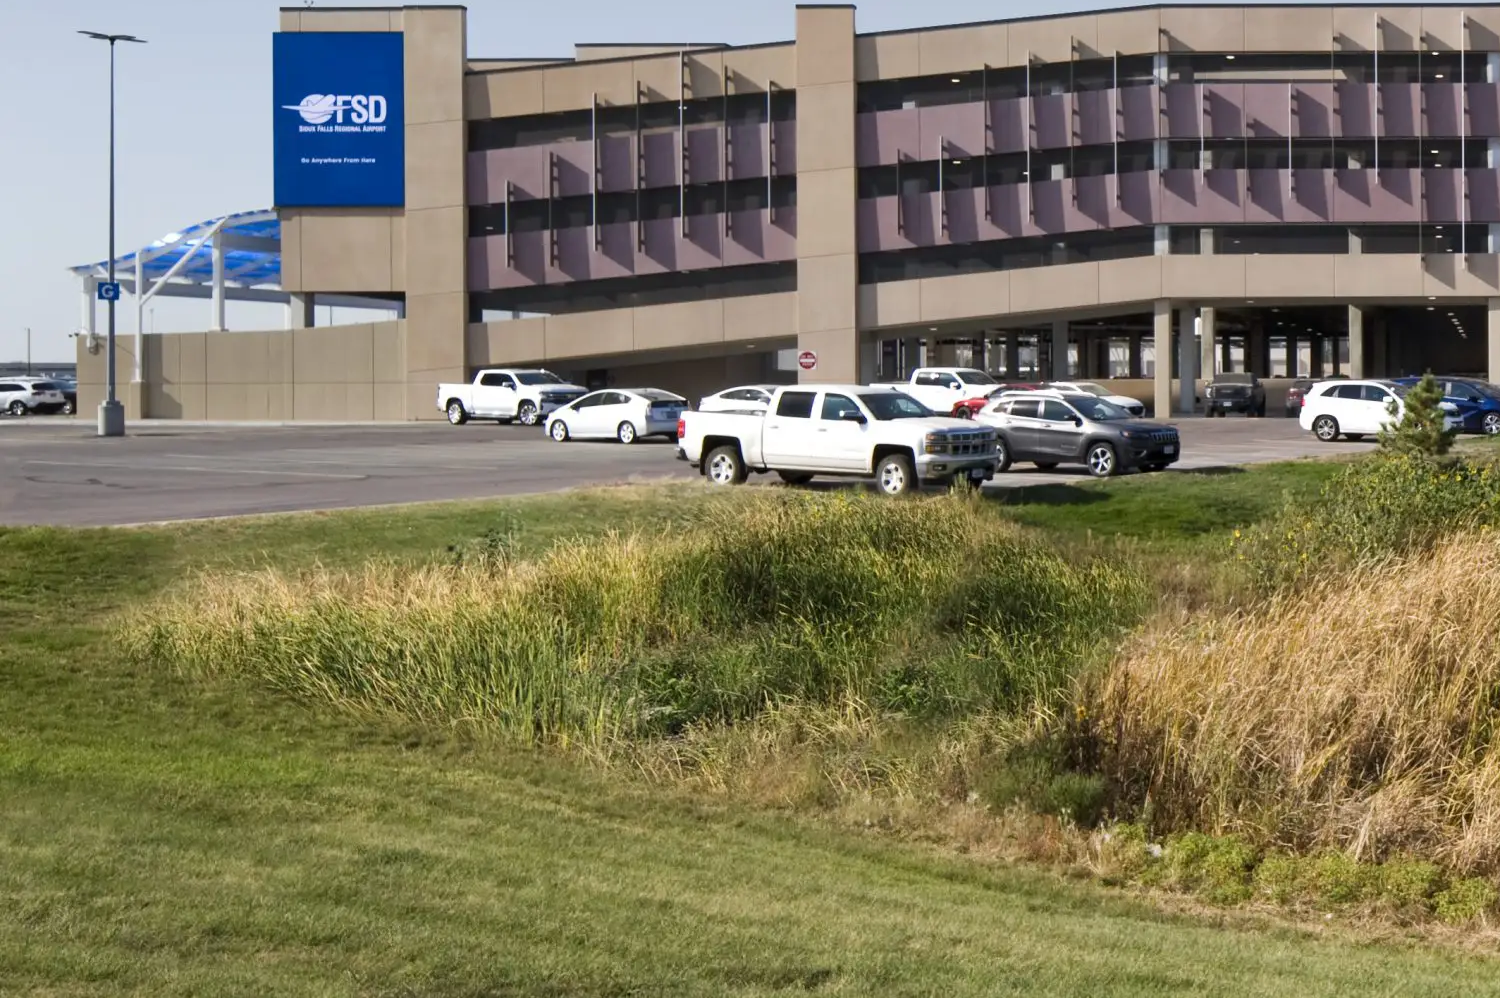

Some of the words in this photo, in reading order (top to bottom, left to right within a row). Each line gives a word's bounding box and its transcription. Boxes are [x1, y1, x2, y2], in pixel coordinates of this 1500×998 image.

[336, 94, 387, 124] FSD
[311, 157, 342, 165] Anywhere
[101, 284, 114, 298] G
